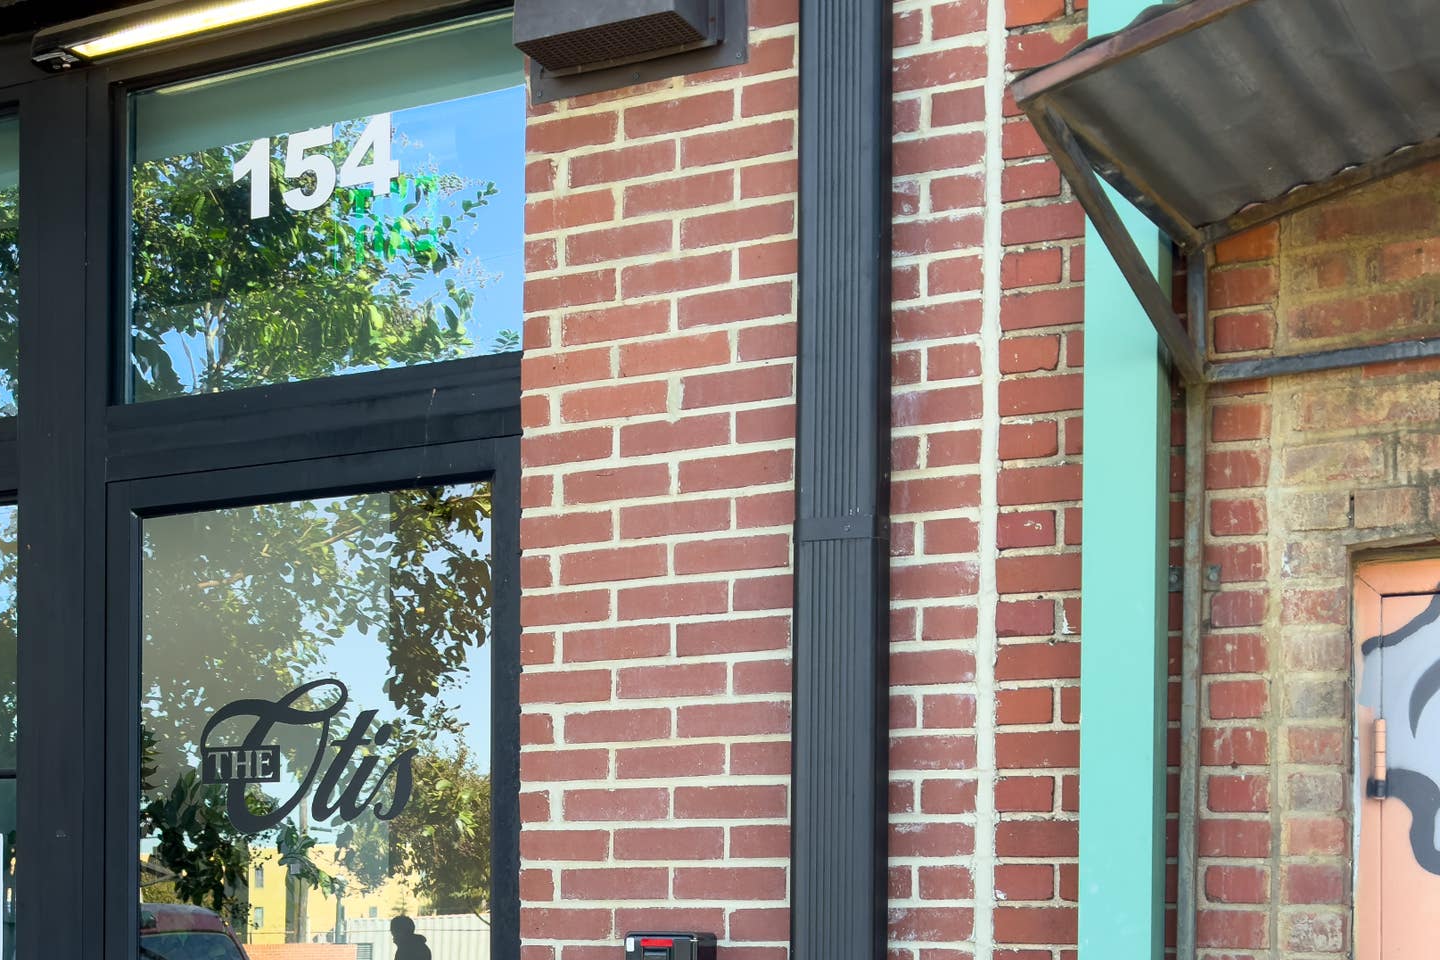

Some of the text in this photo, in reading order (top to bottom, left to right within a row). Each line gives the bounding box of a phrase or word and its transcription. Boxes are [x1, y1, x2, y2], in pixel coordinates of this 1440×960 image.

[232, 112, 400, 220] 154
[200, 678, 420, 835] THE Otis
